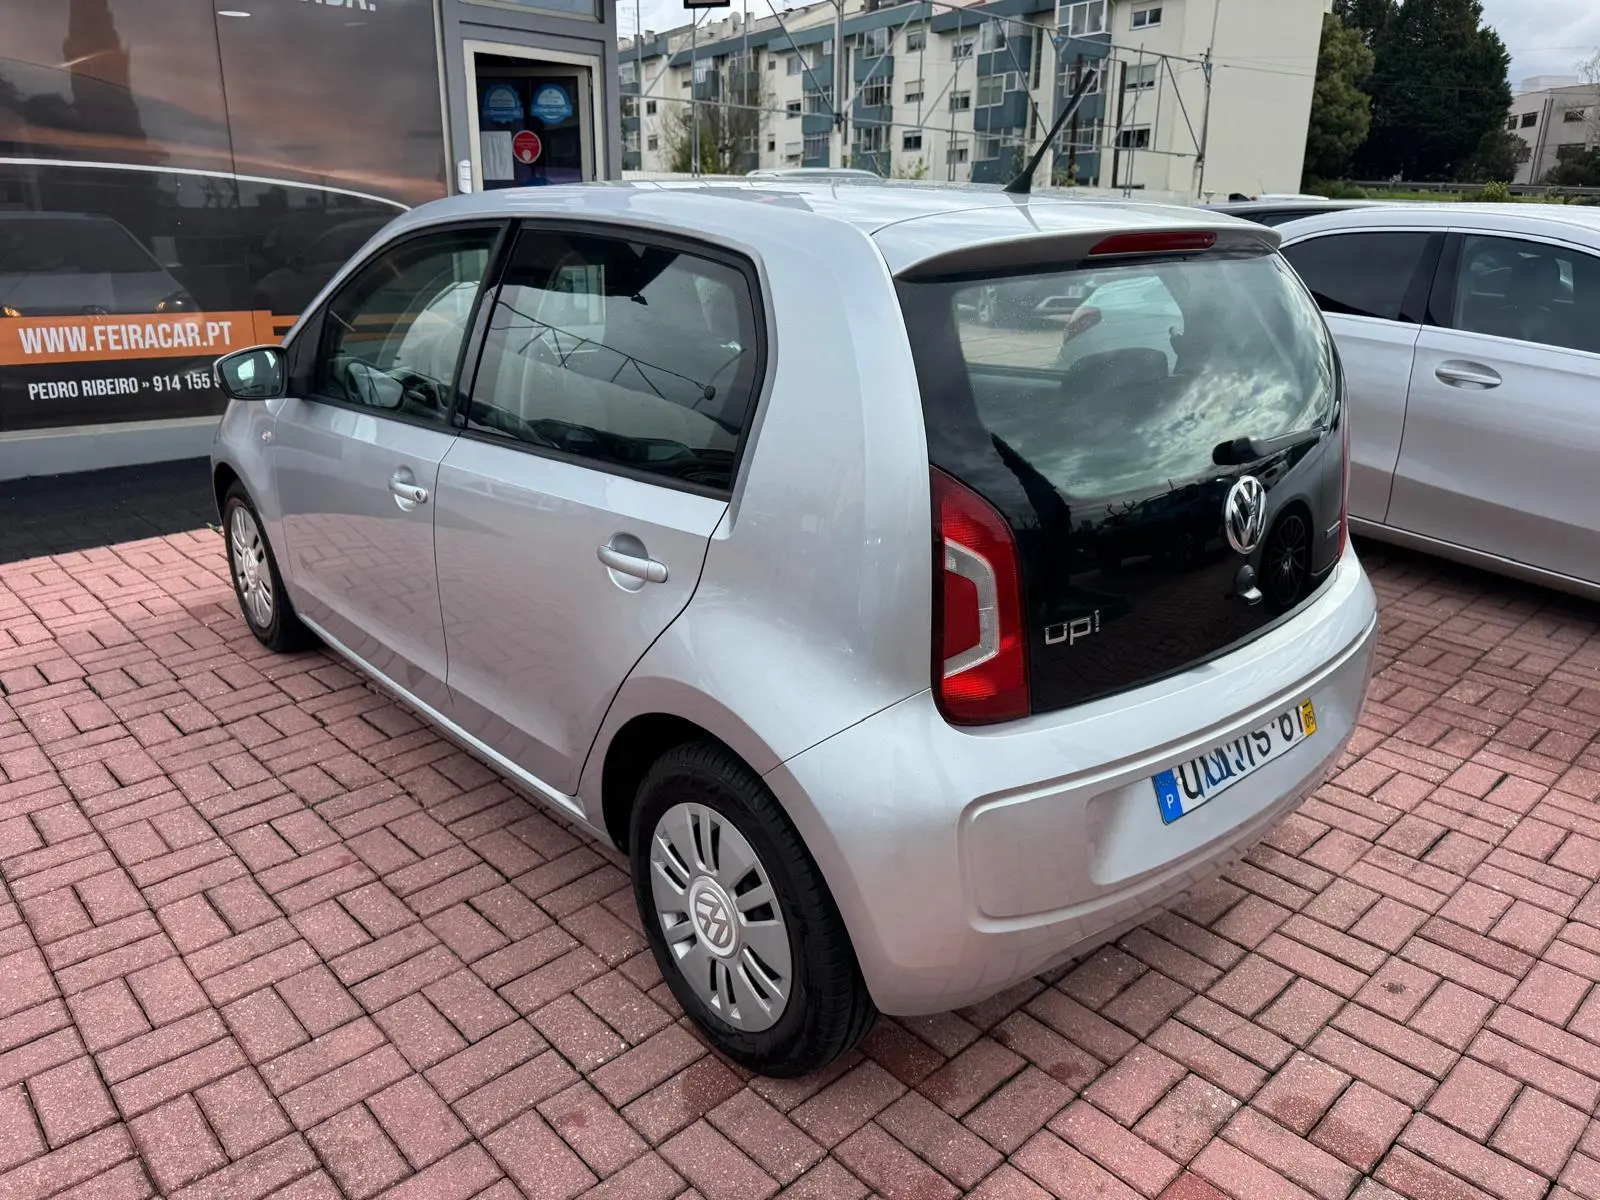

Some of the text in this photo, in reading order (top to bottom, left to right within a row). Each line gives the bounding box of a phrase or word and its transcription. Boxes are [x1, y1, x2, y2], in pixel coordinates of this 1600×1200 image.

[18, 321, 232, 354] WWW.FEIRACAR.PT
[28, 381, 79, 400] PEDRO
[82, 377, 139, 396] RIBEIRO
[152, 374, 181, 392] 914
[184, 372, 211, 389] 155
[1044, 609, 1100, 646] up!
[1165, 794, 1175, 809] P
